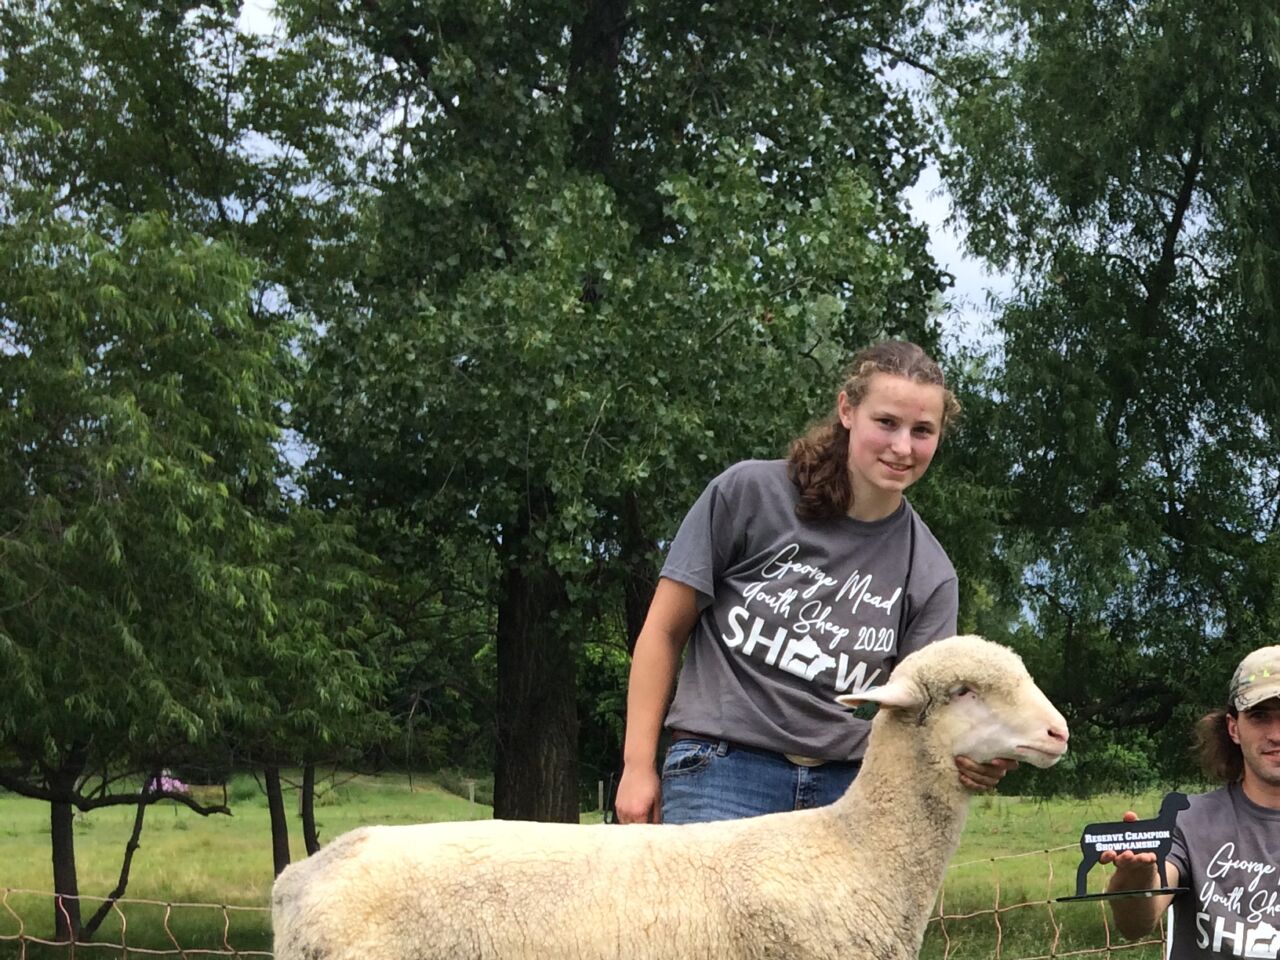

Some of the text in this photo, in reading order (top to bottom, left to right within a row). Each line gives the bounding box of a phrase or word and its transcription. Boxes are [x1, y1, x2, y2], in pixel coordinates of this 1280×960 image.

[761, 543, 903, 616] George Mead
[742, 581, 895, 653] Youth Sheep 2020
[721, 605, 883, 696] SHW
[1084, 830, 1170, 844] RESERVE CHAMPION
[1095, 840, 1161, 852] SHOWMANSHIP
[1206, 842, 1276, 892] George
[1199, 880, 1244, 914] Youth
